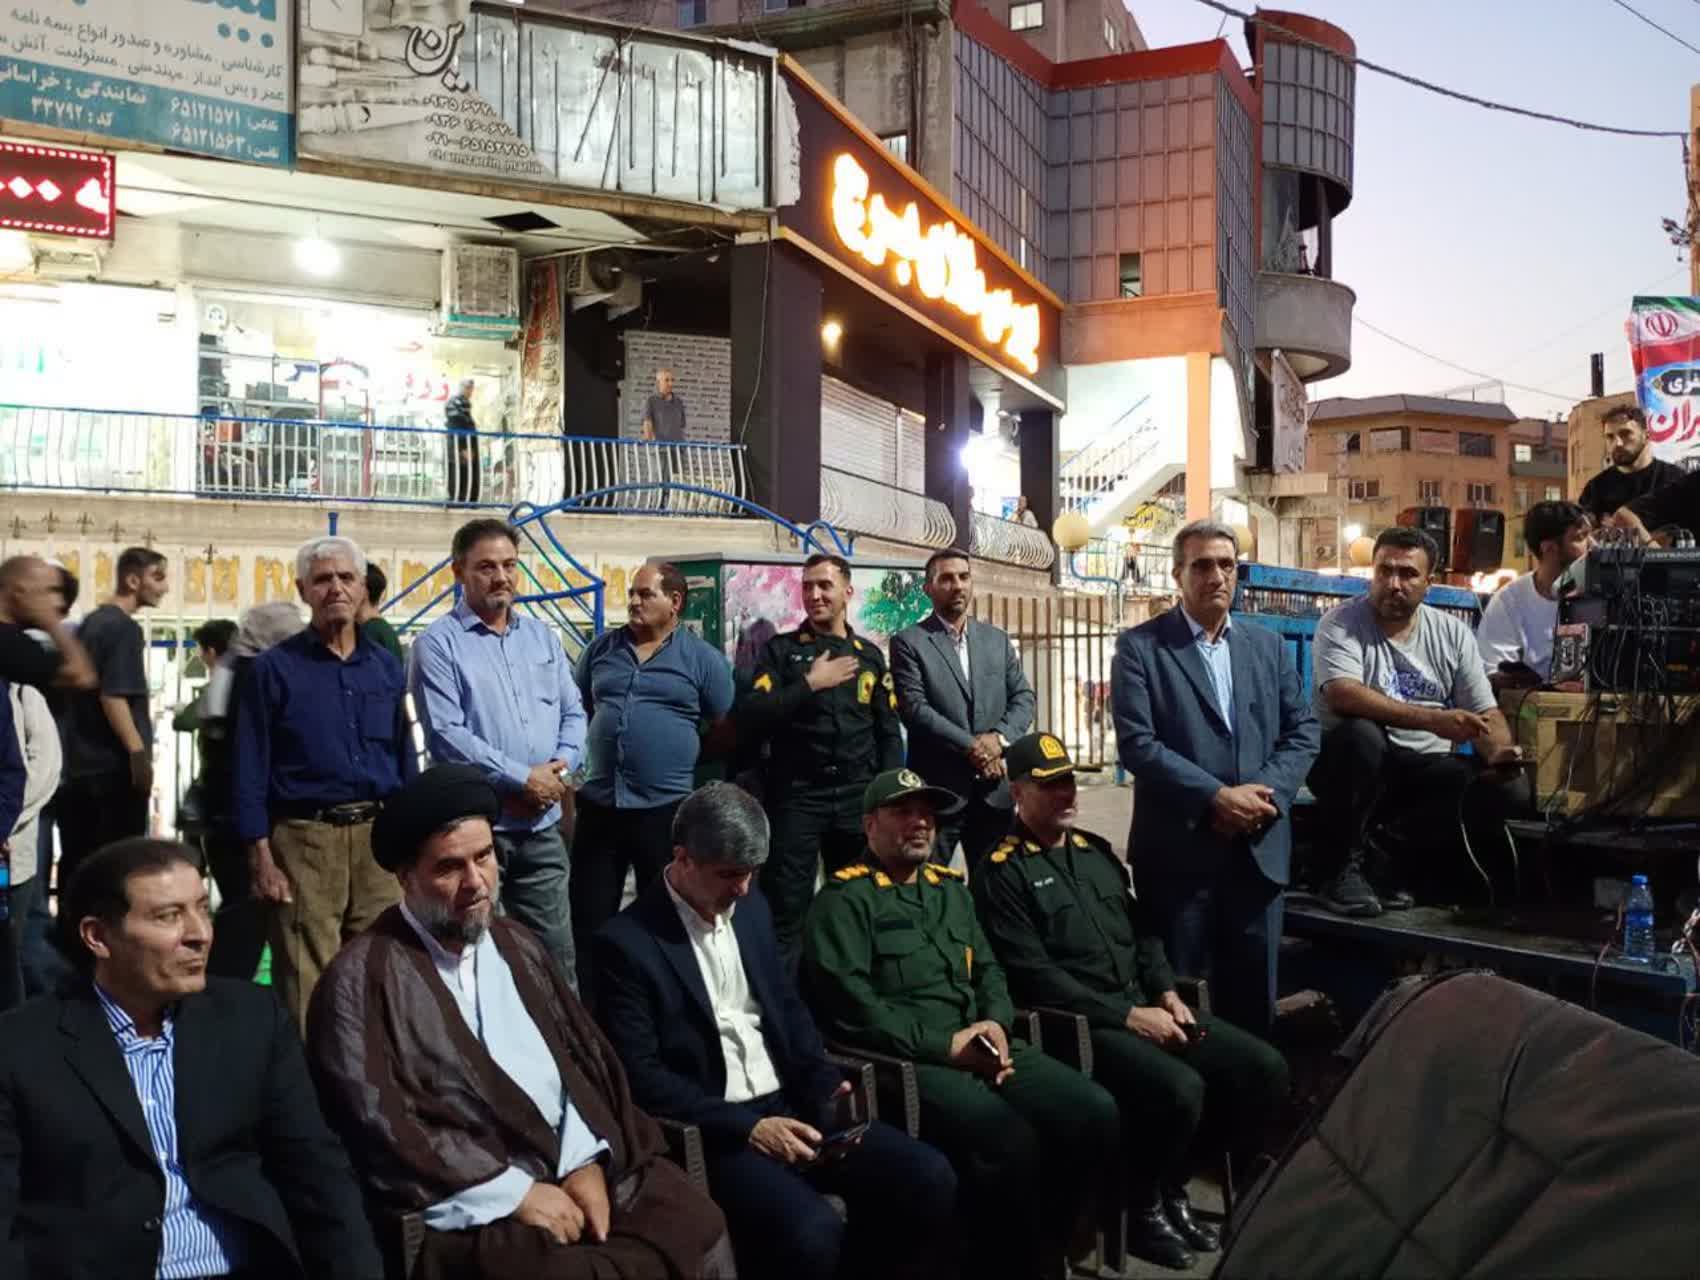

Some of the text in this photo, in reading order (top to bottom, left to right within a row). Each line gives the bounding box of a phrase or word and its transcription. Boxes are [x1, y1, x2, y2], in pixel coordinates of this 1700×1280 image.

[10, 8, 285, 78] کارشناسی مشاوره و صدور انواع بیمه نامه
[12, 33, 47, 53] آتش
[0, 61, 60, 91] خراسان
[128, 62, 184, 81] مهندسی
[193, 71, 222, 87] انداز
[262, 89, 285, 101] عمر
